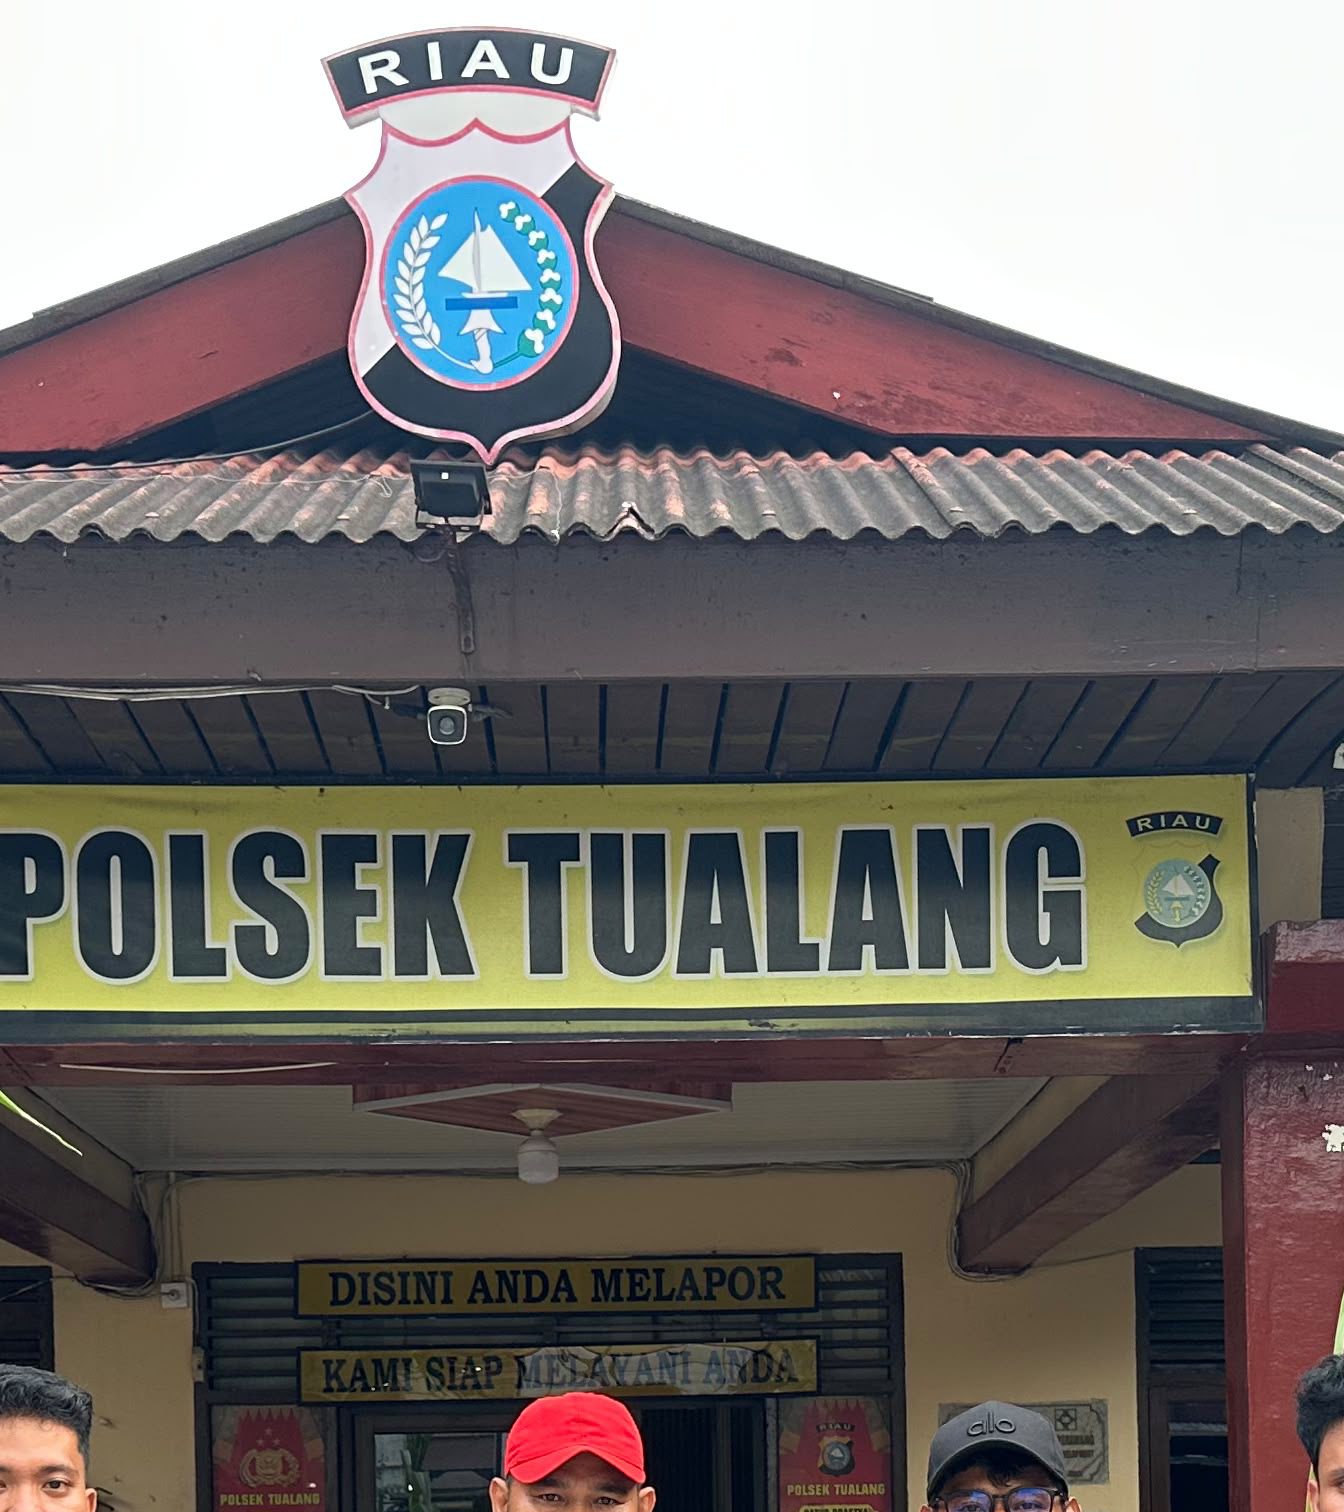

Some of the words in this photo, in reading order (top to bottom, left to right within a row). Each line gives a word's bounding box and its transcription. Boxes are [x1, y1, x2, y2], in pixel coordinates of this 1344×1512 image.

[358, 39, 574, 95] RIAU
[1137, 814, 1210, 832] RIAU
[502, 818, 1088, 981] TUALANG
[329, 1270, 454, 1307] DISINI
[467, 1268, 578, 1305] ANDA
[590, 1265, 786, 1303] MELAPOR
[322, 1356, 413, 1394] KAMI
[425, 1355, 503, 1391] SIAP
[514, 1350, 691, 1389] MELAYANI
[701, 1349, 800, 1385] ANDA
[967, 1412, 1016, 1437] alo
[220, 1493, 264, 1506] POLSEK
[268, 1493, 321, 1506] TUALANG
[787, 1484, 830, 1496] POLSEK
[833, 1483, 886, 1495] TUALANG
